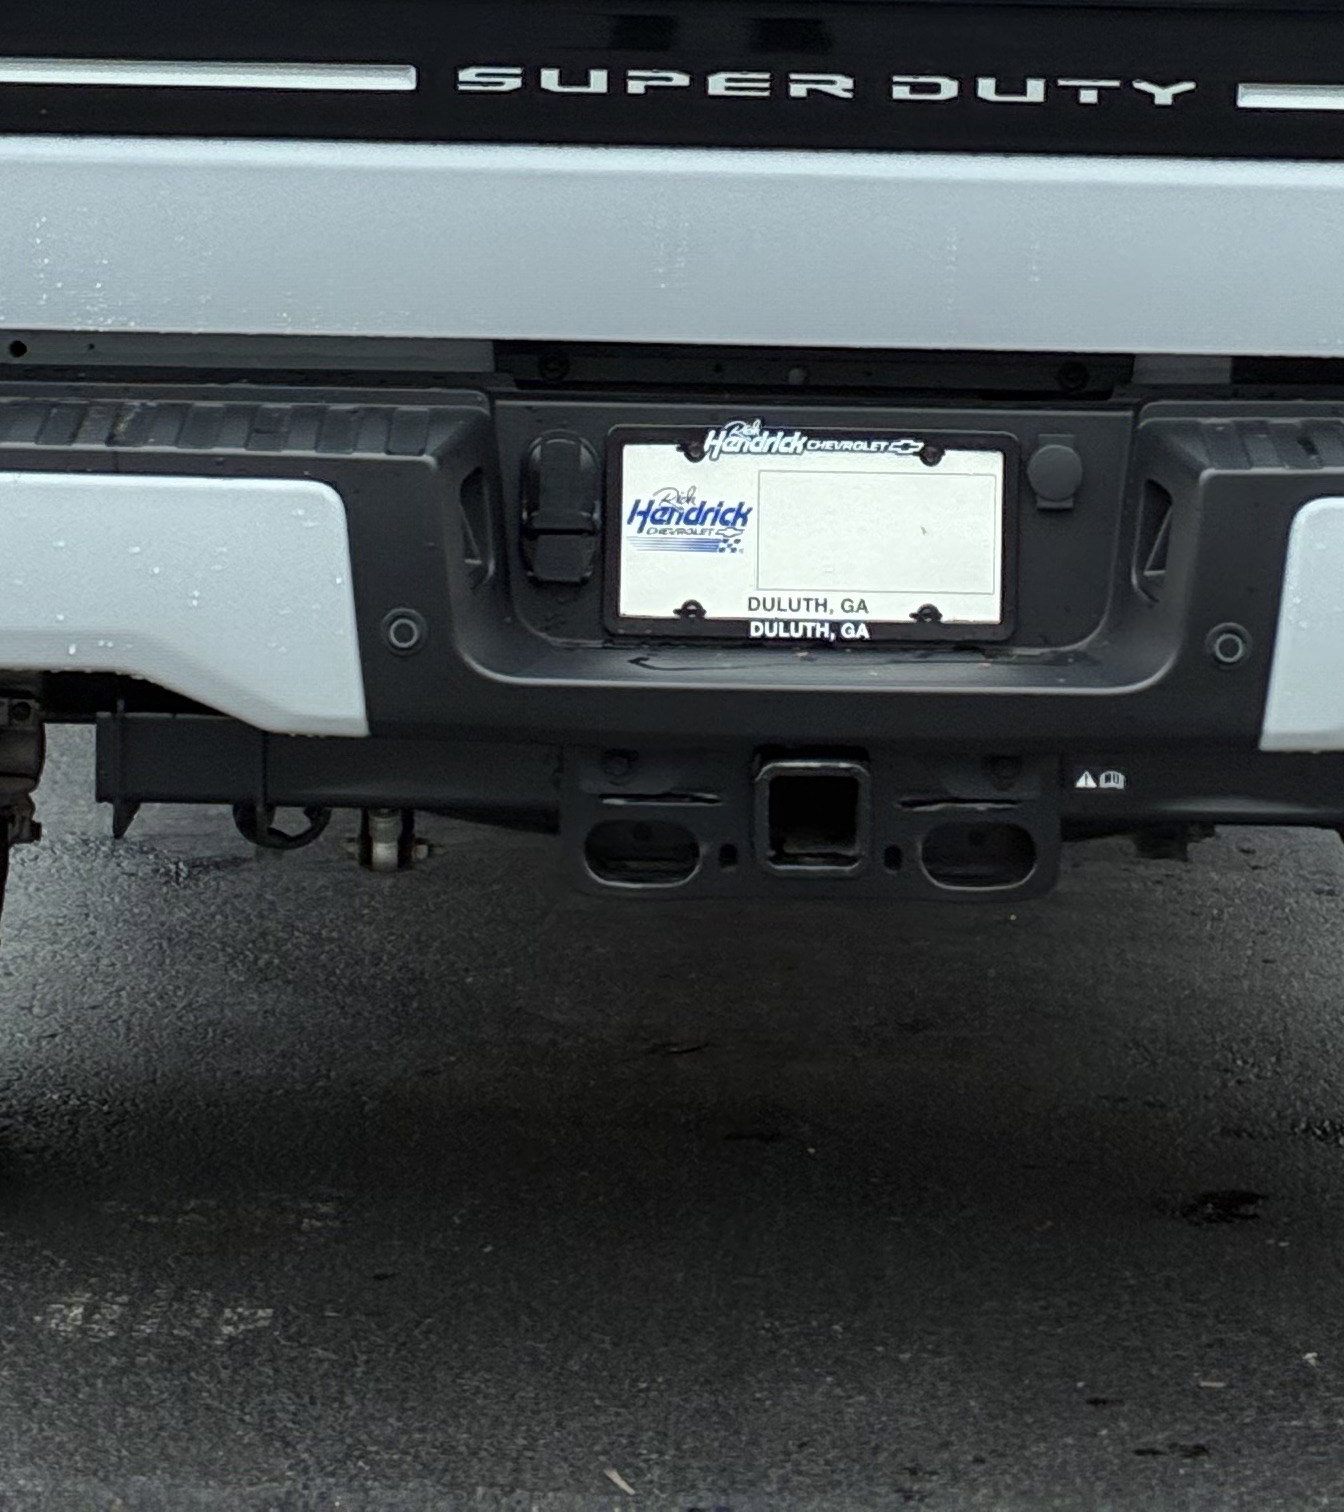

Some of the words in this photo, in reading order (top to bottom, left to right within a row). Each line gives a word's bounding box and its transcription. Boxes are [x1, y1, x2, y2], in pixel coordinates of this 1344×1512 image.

[456, 66, 854, 99] SUPER
[892, 74, 1197, 106] DUTY
[704, 428, 807, 460] Hendrick
[807, 439, 890, 452] CHEVROLET
[627, 499, 753, 534] Hendrick
[646, 527, 714, 536] CHEVROLET
[748, 596, 834, 615] DULUTH,
[841, 598, 869, 614] GA
[750, 621, 835, 642] DULUTH,
[841, 622, 870, 640] GA
